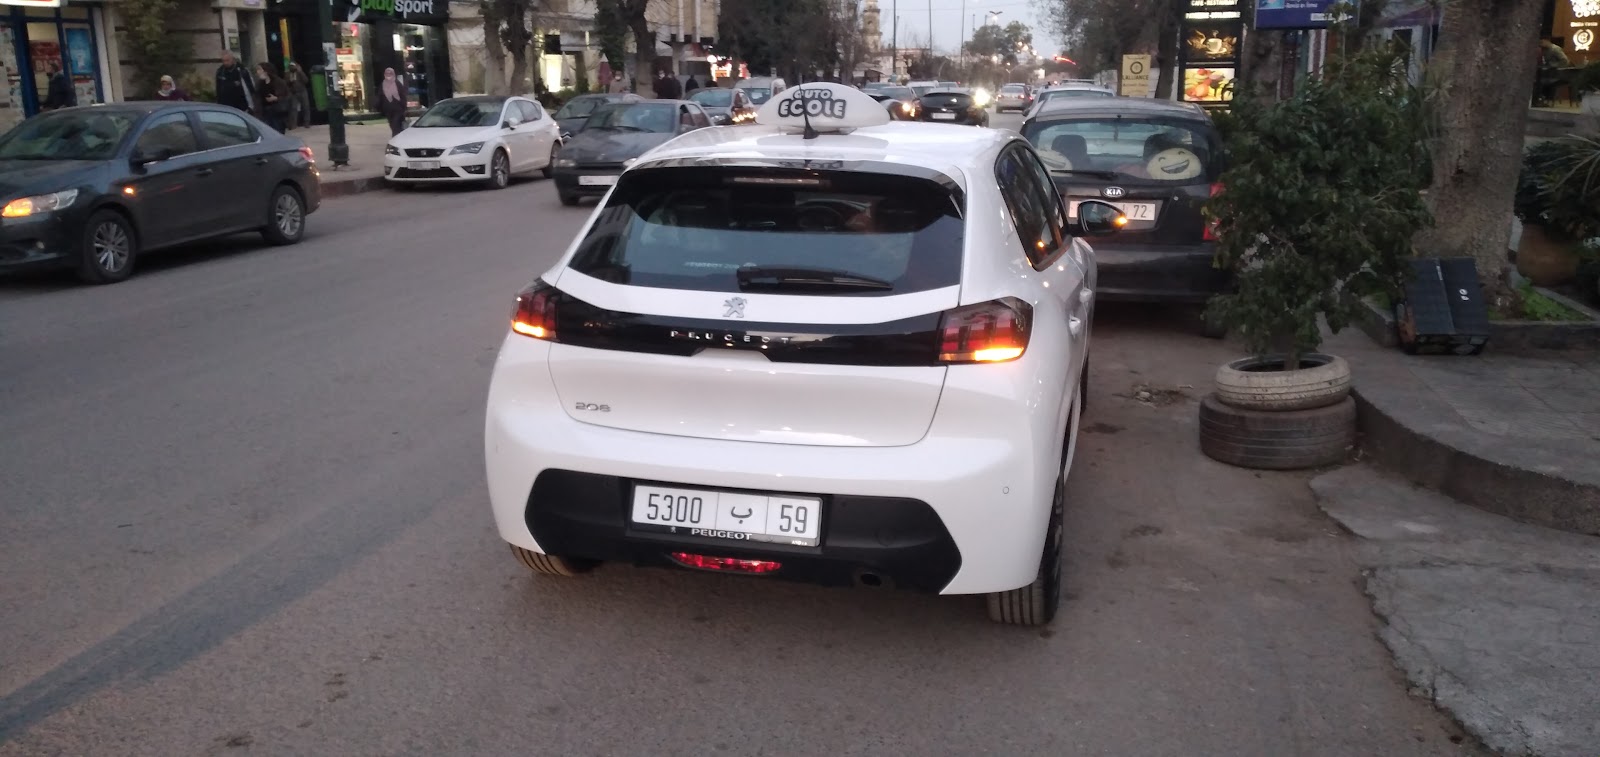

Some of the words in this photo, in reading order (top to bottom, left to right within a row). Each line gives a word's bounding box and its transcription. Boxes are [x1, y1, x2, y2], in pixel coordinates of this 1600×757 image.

[793, 89, 832, 100] AUTO
[778, 99, 846, 119] ECOLE
[1106, 188, 1122, 196] KIA
[1133, 204, 1147, 218] 72
[670, 330, 789, 345] PEUGEOT
[647, 493, 703, 524] 5300
[730, 505, 753, 524] ب
[779, 504, 808, 533] 59
[691, 528, 753, 540] PEUGEOT
